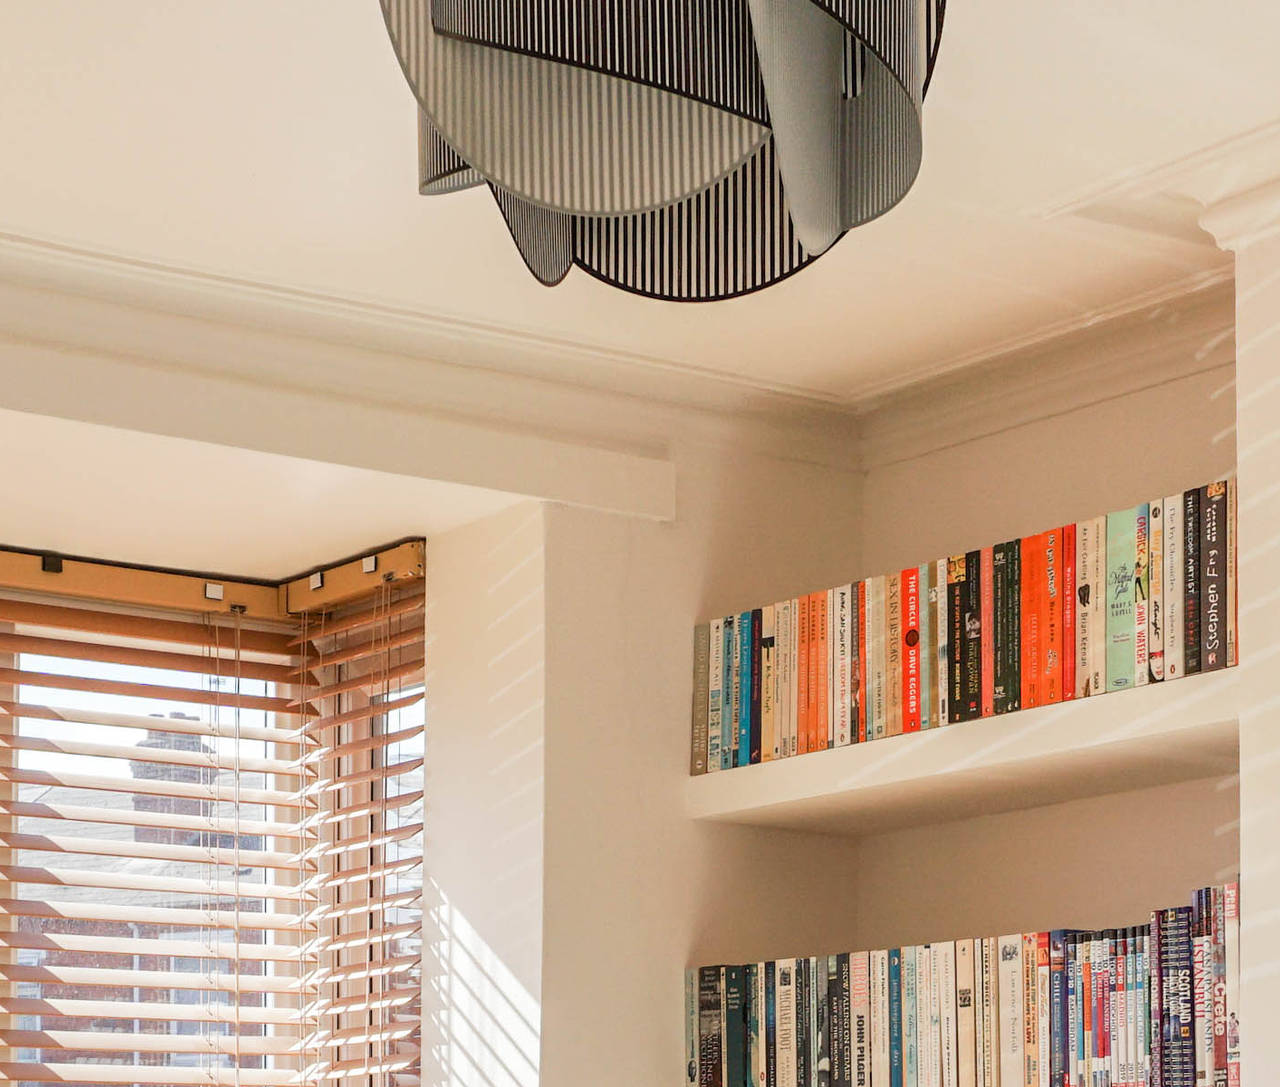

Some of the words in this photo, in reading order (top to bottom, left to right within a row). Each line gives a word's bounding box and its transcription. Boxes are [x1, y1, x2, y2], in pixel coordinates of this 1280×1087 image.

[1136, 516, 1146, 554] CARSICK
[1206, 550, 1218, 577] Fry
[889, 578, 898, 600] SEX
[889, 602, 898, 614] IN
[1136, 603, 1145, 626] JOHN
[1206, 584, 1219, 650] Stephen
[889, 619, 898, 665] HISTORY
[1136, 631, 1145, 665] WATERS
[852, 956, 867, 1009] HEROES
[1179, 970, 1191, 1023] SCOTLAND
[1204, 999, 1212, 1053] ISLANDS
[1214, 982, 1225, 1036] Crete
[780, 1030, 791, 1052] FOOT
[842, 1030, 849, 1044] ON
[856, 1015, 865, 1044] JOHN
[856, 1047, 865, 1087] PILGER
